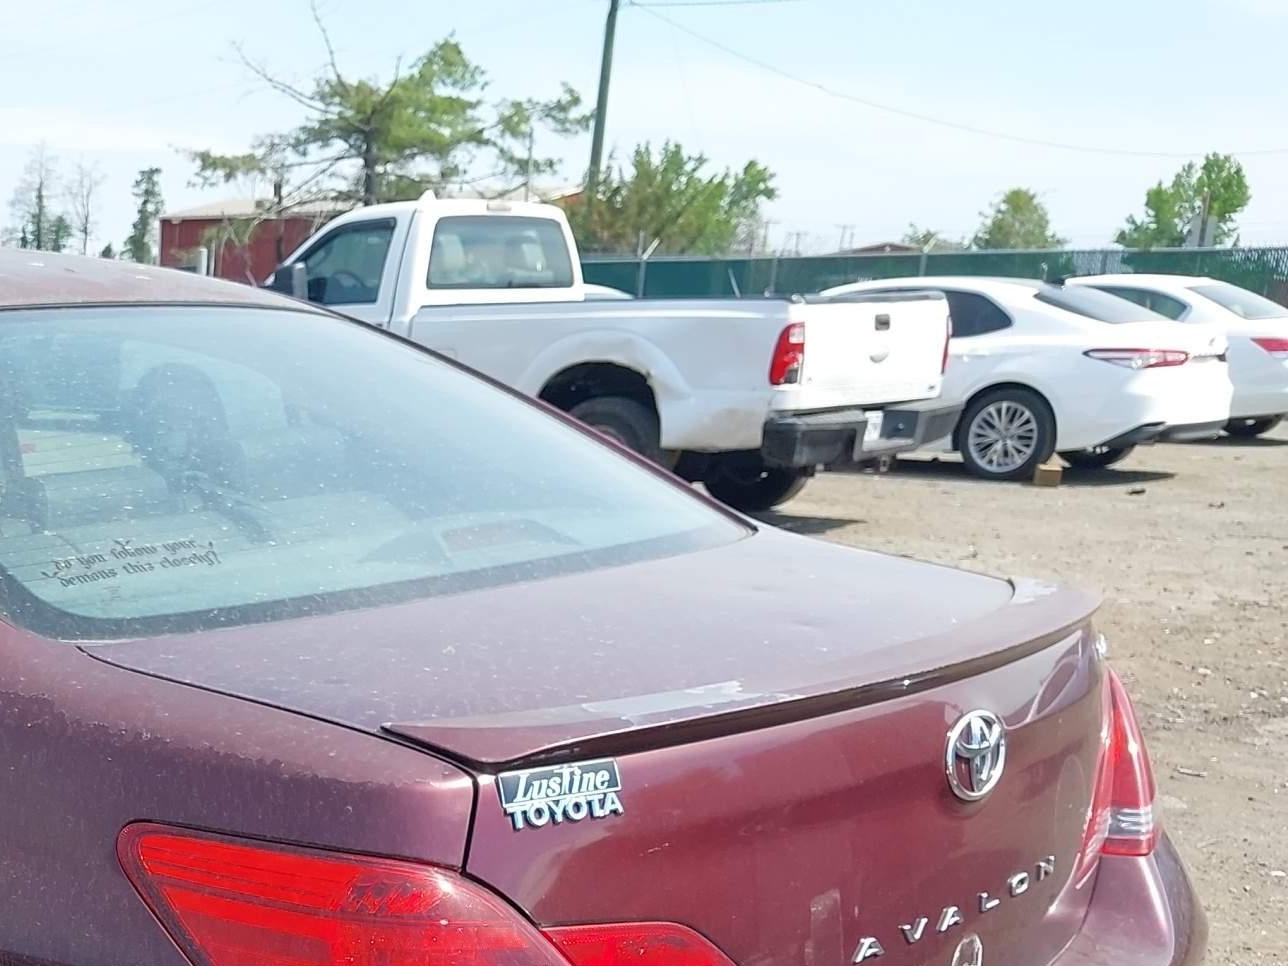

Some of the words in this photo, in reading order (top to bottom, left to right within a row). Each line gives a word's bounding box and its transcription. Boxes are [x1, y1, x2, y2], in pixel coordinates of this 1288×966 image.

[161, 540, 198, 555] your
[122, 561, 155, 575] this
[506, 792, 625, 831] TOYOTA
[851, 855, 1055, 964] AVALON
